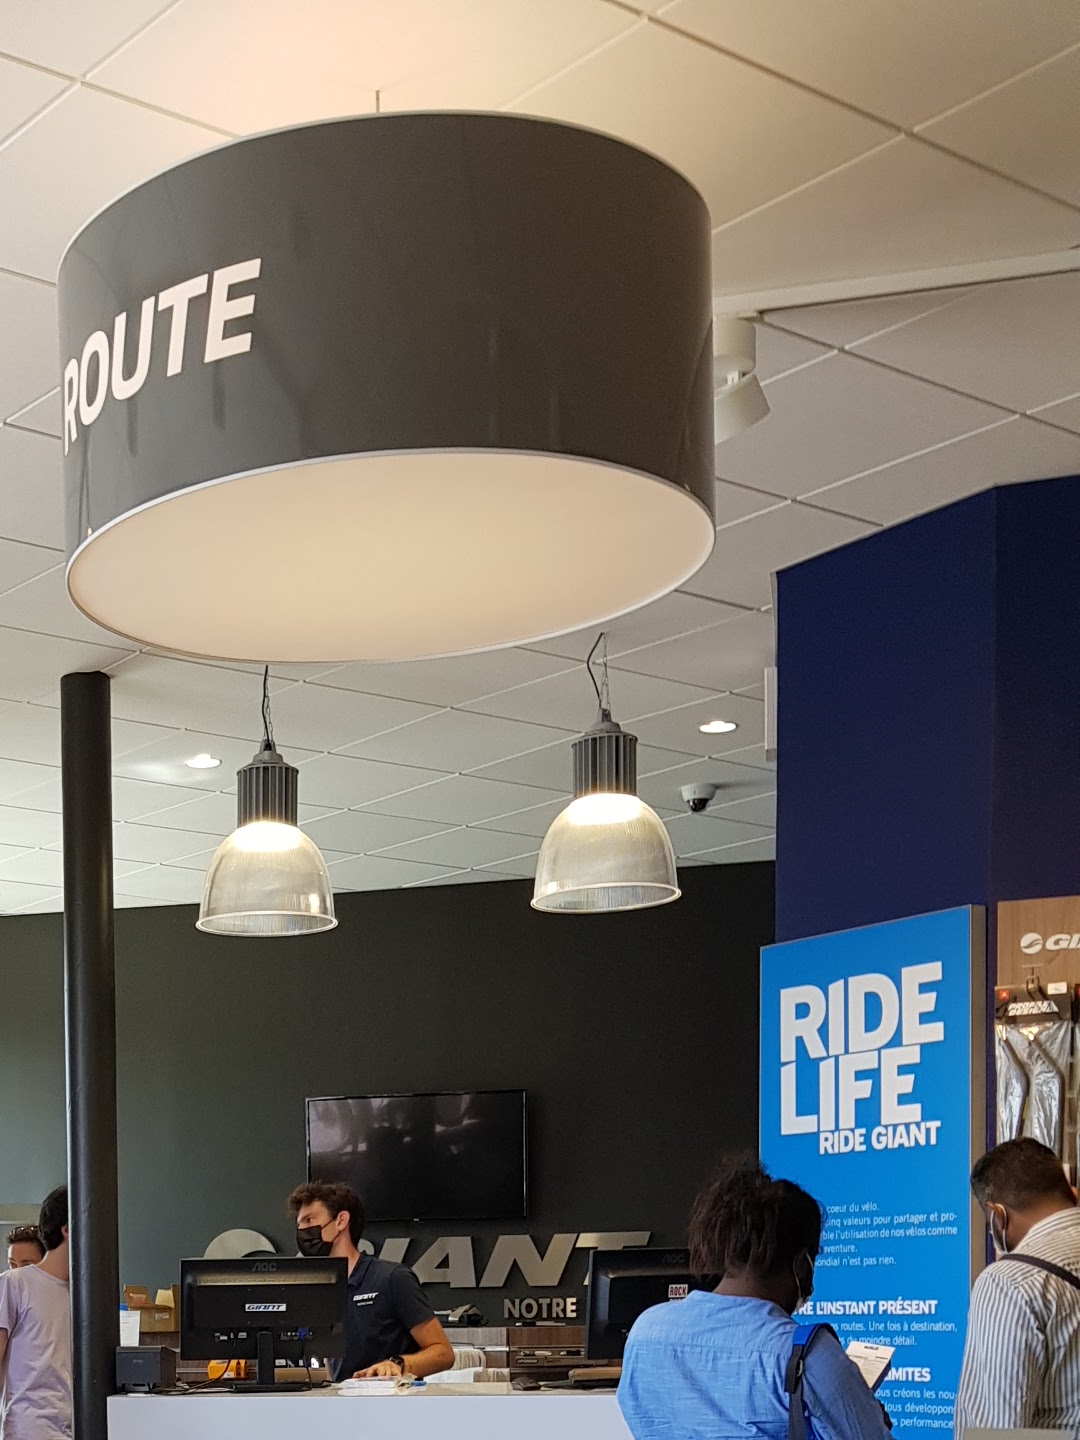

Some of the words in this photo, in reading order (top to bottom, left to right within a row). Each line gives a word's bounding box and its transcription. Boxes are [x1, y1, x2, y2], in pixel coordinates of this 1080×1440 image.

[63, 258, 262, 456] ROUTE
[779, 961, 945, 1063] RIDE
[779, 1044, 922, 1136] LIFE
[819, 1127, 867, 1155] RIDE
[870, 1120, 942, 1150] GIANT
[849, 1203, 860, 1212] du
[861, 1202, 880, 1212] vélo.
[843, 1215, 872, 1226] valeurs
[873, 1216, 891, 1226] pour
[894, 1212, 927, 1226] partager
[929, 1212, 939, 1222] et
[880, 1228, 890, 1238] de
[891, 1229, 905, 1238] nos
[905, 1226, 927, 1237] vélos
[927, 1227, 958, 1236] comme
[252, 1262, 277, 1272] AOC
[862, 1257, 877, 1267] pas
[669, 1285, 687, 1296] ROCK
[503, 1297, 577, 1319] NOTRE
[816, 1300, 877, 1316] L'INSTANT
[878, 1296, 938, 1315] PRÉSENT
[840, 1322, 866, 1332] routes.
[868, 1321, 885, 1331] Une
[887, 1321, 901, 1331] fois
[903, 1321, 909, 1331] à
[910, 1321, 958, 1333] destination,
[892, 1388, 920, 1399] créons
[923, 1388, 936, 1399] les
[904, 1402, 955, 1415] développon
